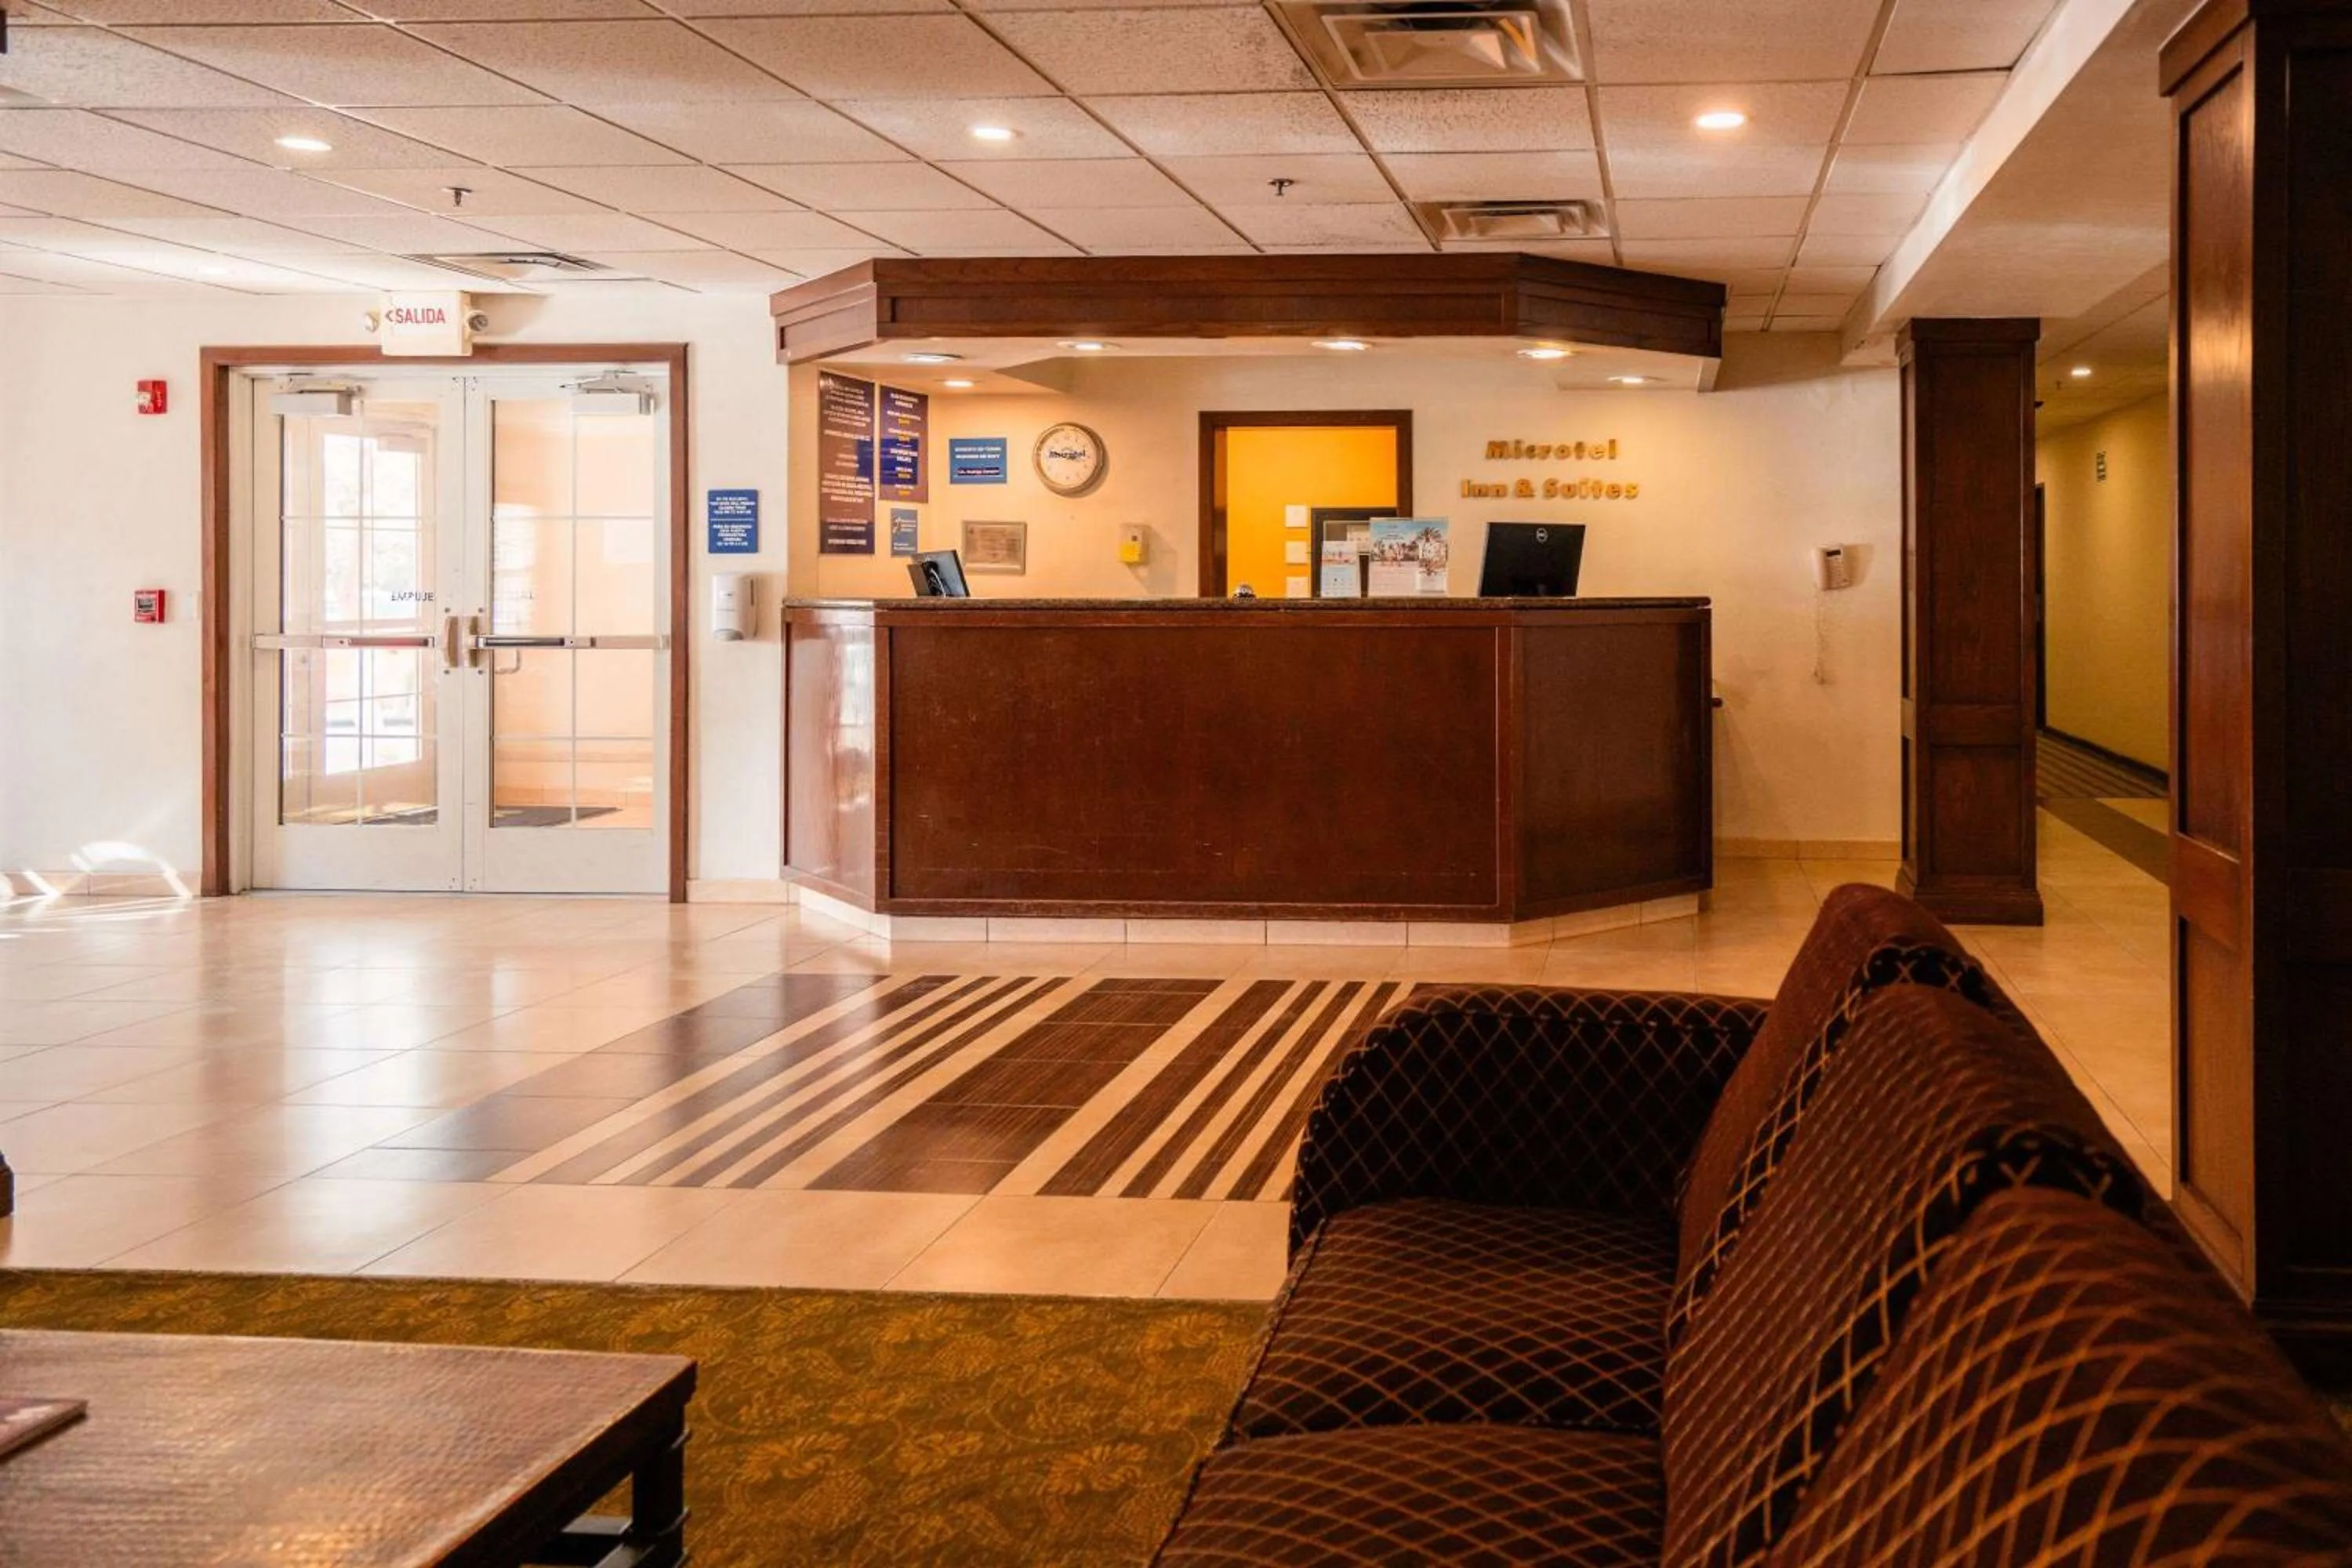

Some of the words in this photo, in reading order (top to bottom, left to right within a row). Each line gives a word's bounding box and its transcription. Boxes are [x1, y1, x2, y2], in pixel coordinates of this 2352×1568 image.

[395, 308, 446, 324] SALIDA
[1486, 439, 1617, 460] Microtel
[1461, 479, 1508, 499] Inn
[1515, 478, 1535, 499] &
[1542, 478, 1639, 500] Suites
